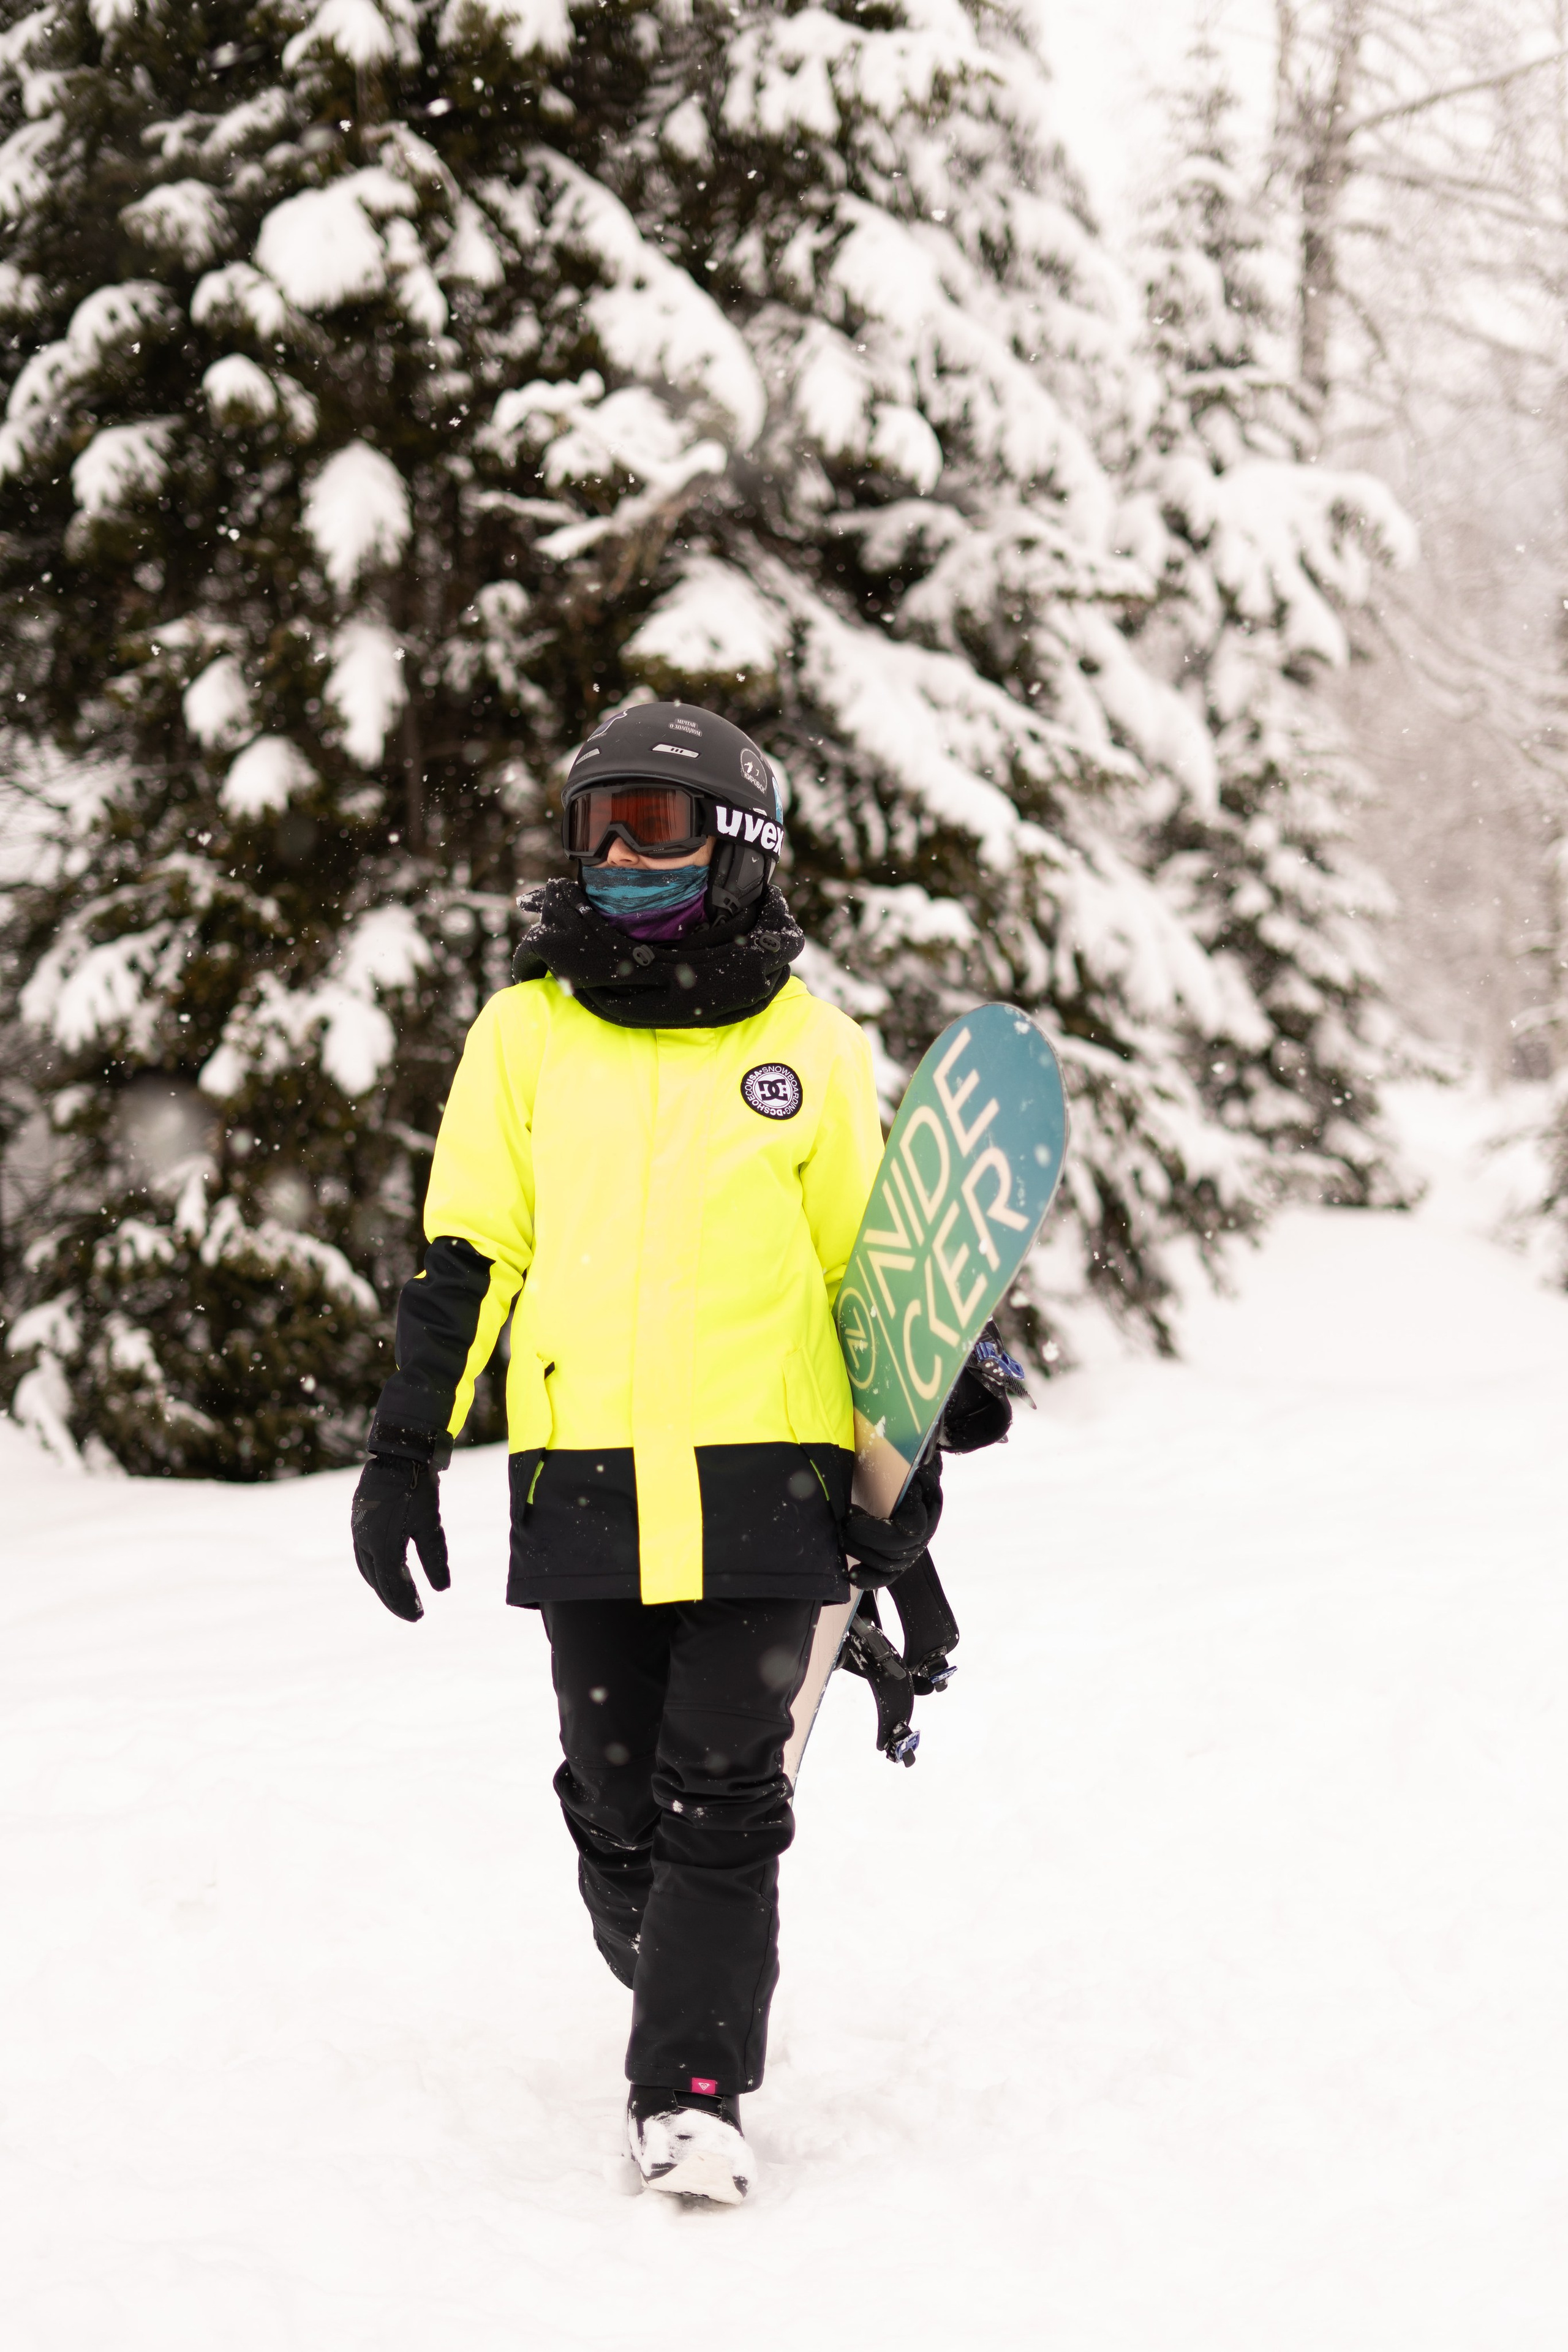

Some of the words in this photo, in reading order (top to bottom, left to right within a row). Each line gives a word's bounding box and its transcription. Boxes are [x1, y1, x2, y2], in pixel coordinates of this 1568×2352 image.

[675, 724, 701, 736] ХОЛОДНОМ
[715, 805, 784, 856] uvex
[758, 1078, 788, 1101] DC
[761, 1066, 799, 1115] SNOWBOARDING
